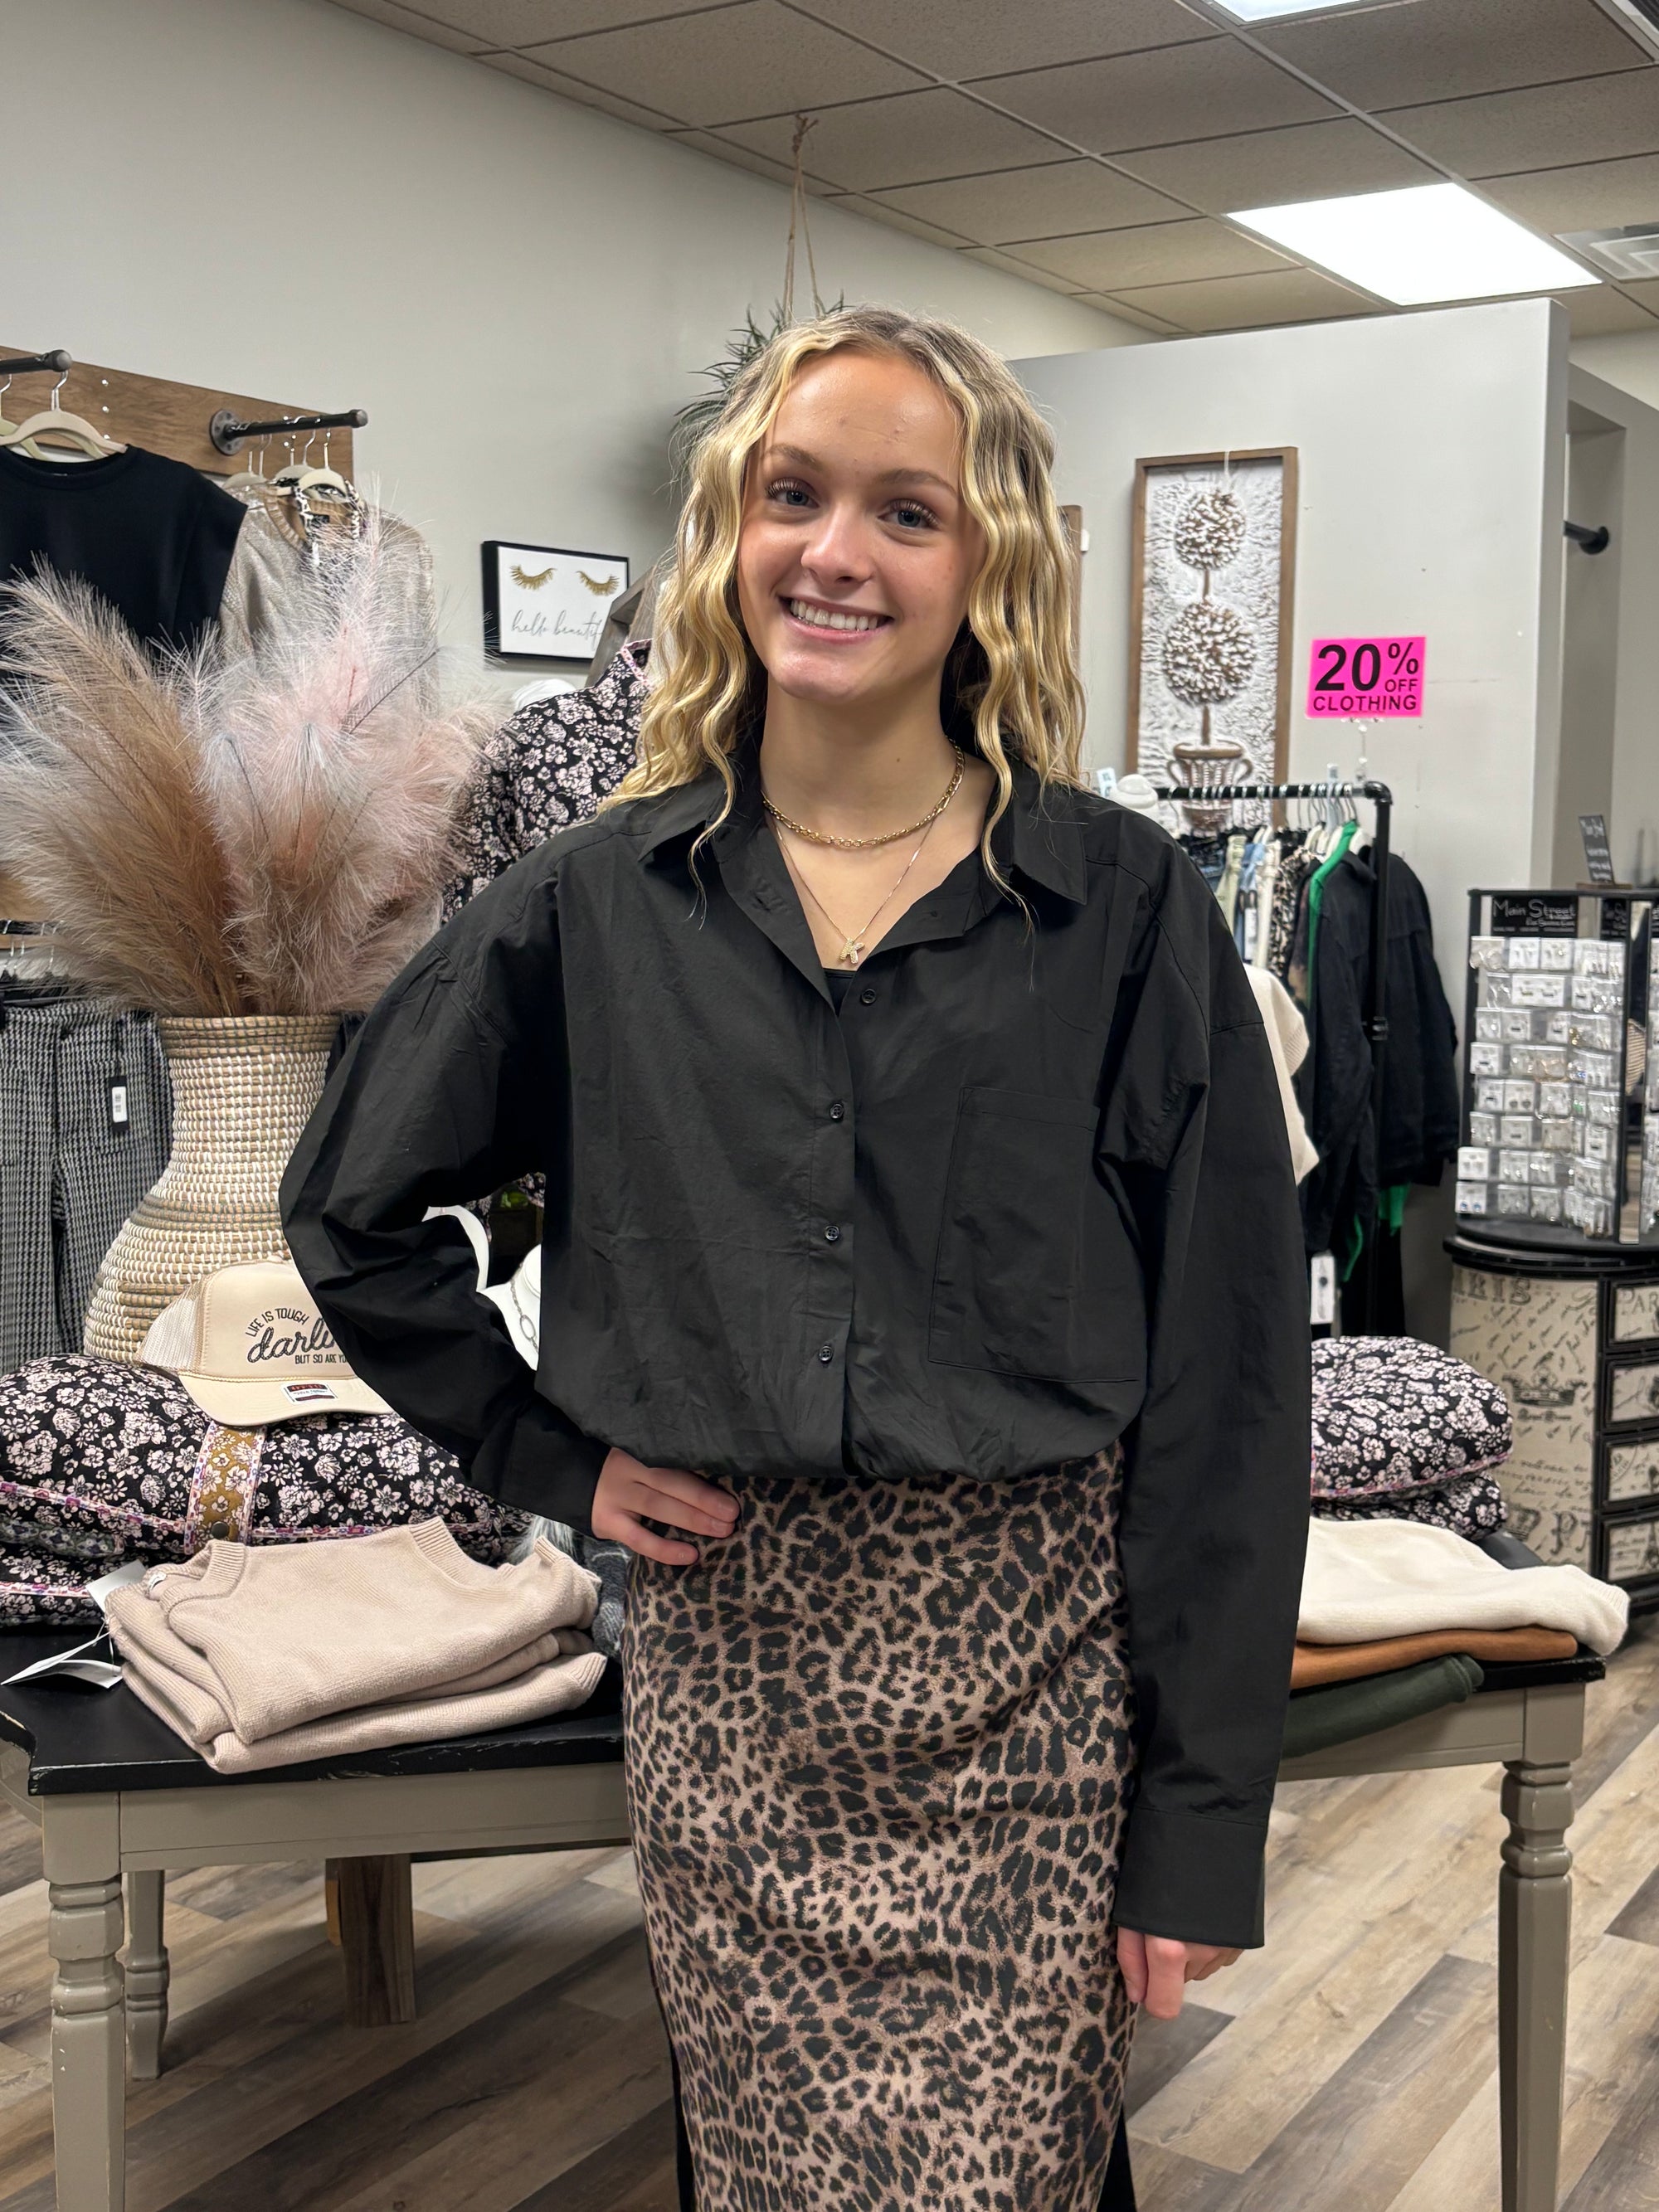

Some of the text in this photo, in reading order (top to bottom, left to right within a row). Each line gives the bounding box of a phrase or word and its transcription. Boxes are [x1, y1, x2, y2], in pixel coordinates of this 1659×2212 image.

[512, 610, 603, 651] hello beautif
[1315, 642, 1418, 693] 20% OFF
[1313, 695, 1417, 712] CLOTHING
[1492, 898, 1576, 919] Main Street
[246, 1307, 309, 1337] LIFE IS TOUGH
[247, 1317, 335, 1363] darli
[295, 1354, 348, 1364] BUT SO ARE YO
